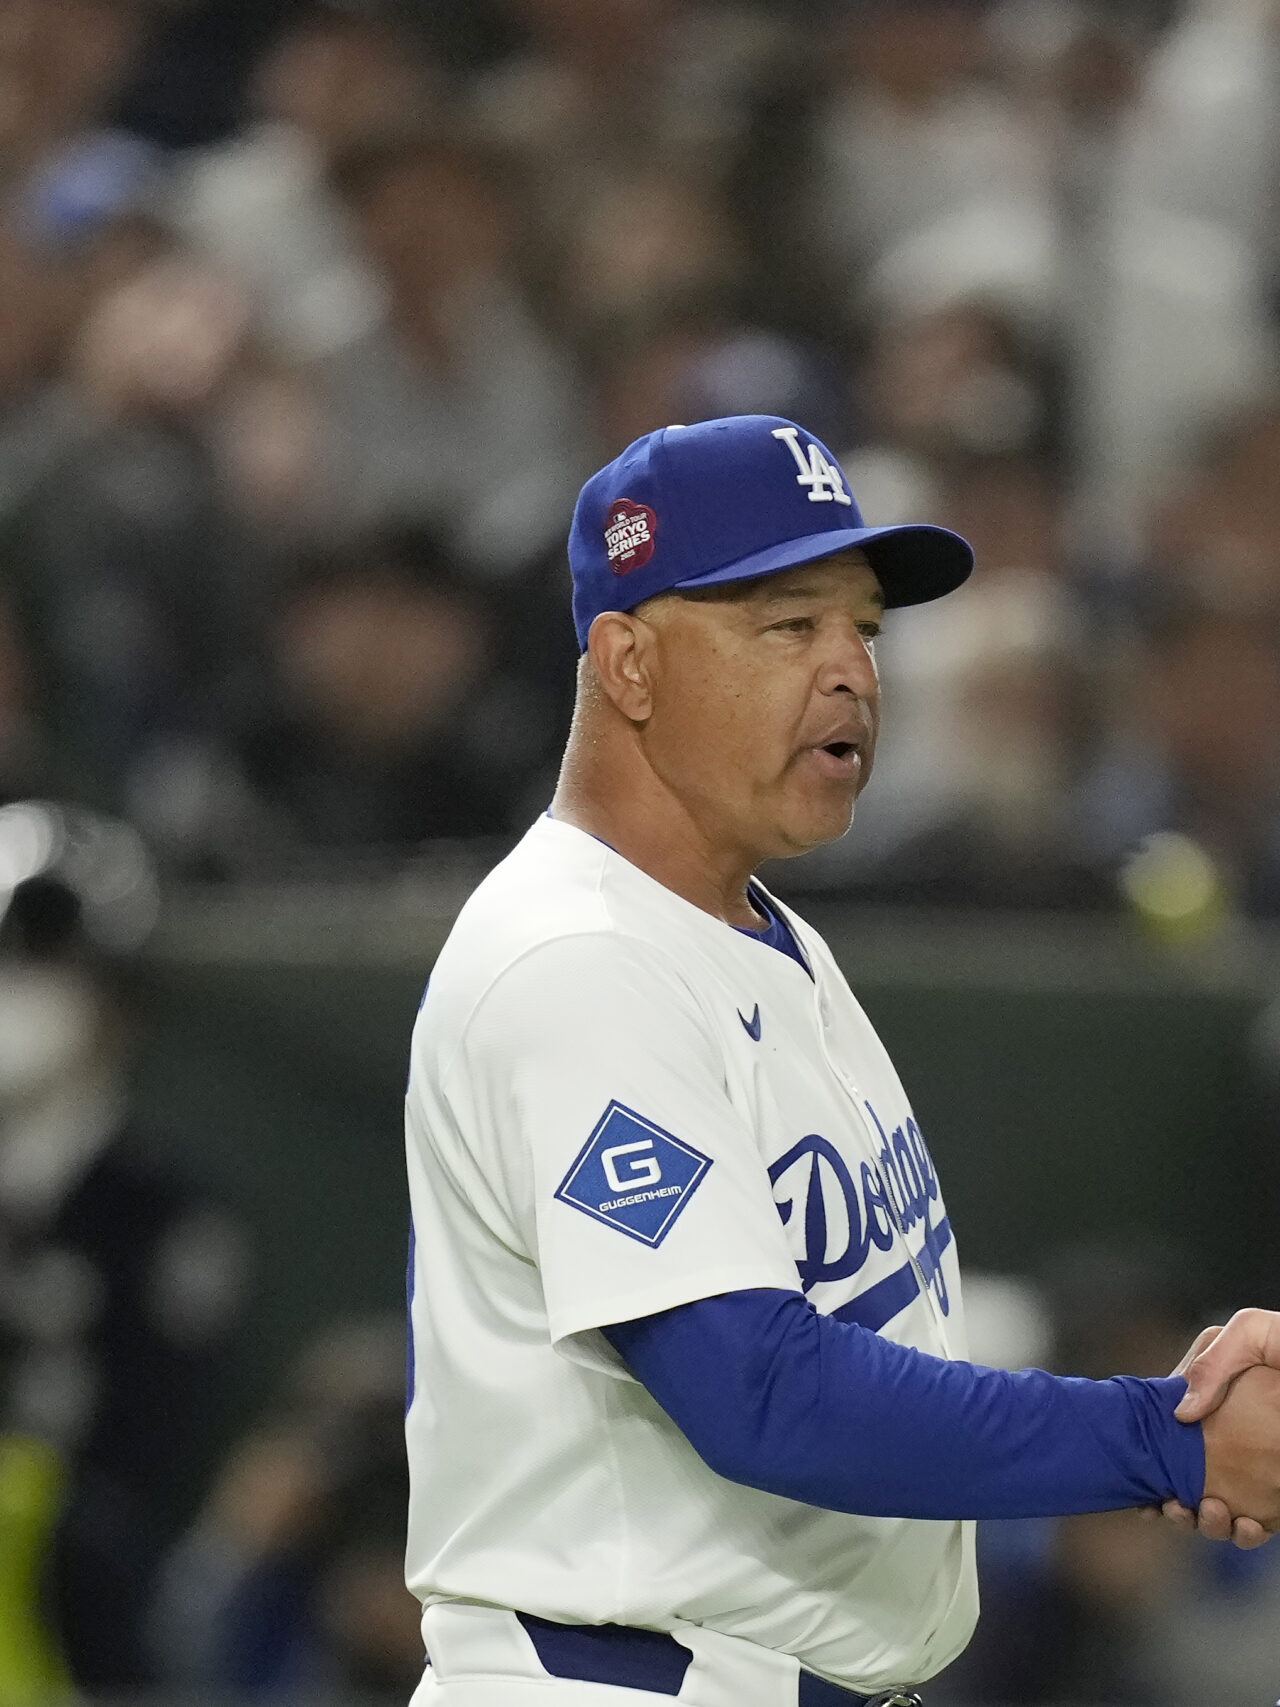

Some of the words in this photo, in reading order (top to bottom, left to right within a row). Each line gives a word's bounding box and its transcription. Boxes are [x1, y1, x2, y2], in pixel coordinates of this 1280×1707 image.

[772, 428, 852, 506] LA
[606, 520, 647, 548] TOKYO
[608, 530, 651, 560] SERIES
[601, 1139, 662, 1192] G
[598, 1185, 682, 1212] GUGGENHEIM
